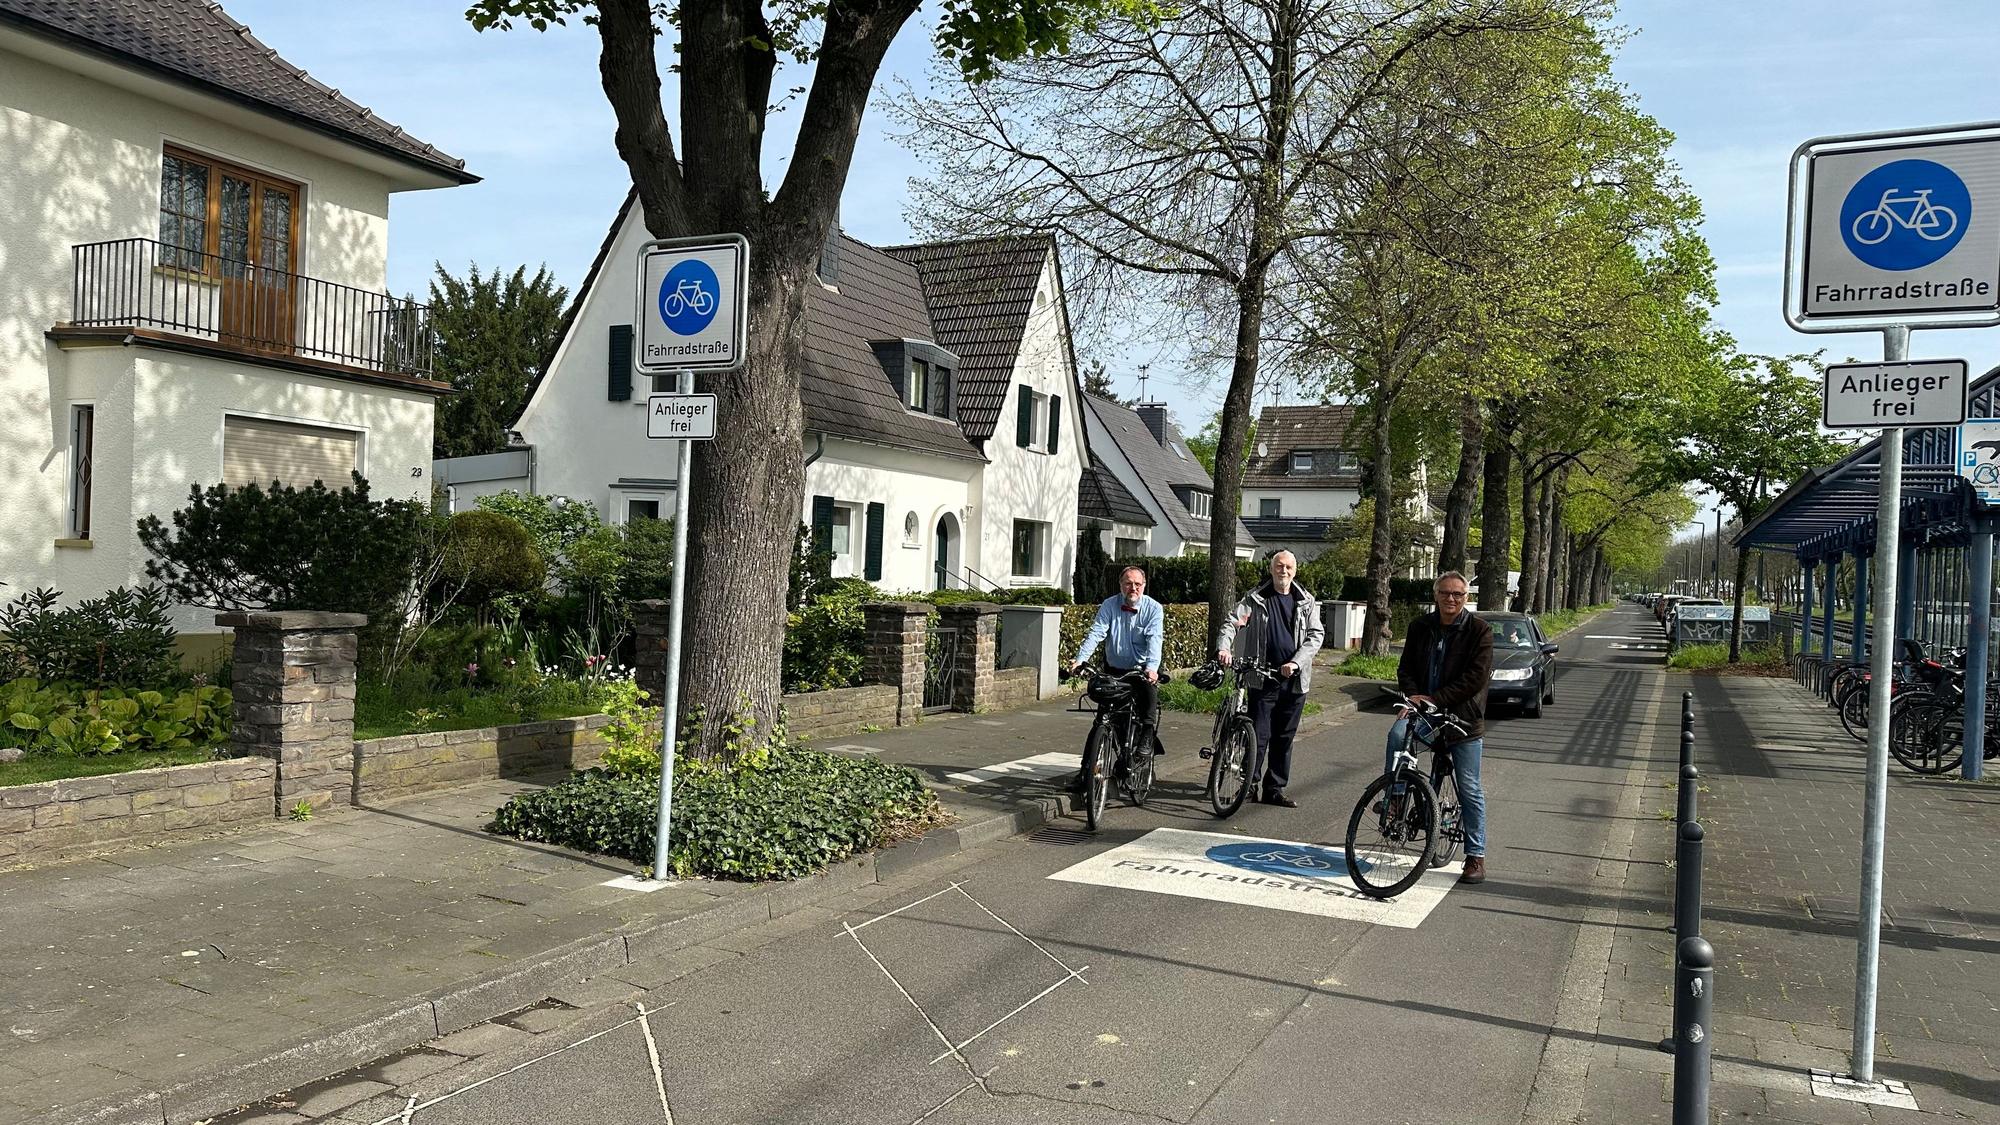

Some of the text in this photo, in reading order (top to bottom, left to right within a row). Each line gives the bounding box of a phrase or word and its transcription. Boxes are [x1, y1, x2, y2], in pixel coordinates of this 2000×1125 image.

[1815, 278, 1990, 303] Fahrradstraße
[647, 340, 729, 357] Fahrradstraße
[1840, 373, 1950, 397] Anlieger
[655, 402, 708, 419] Anlieger
[1872, 398, 1916, 417] frei
[670, 419, 692, 433] frei
